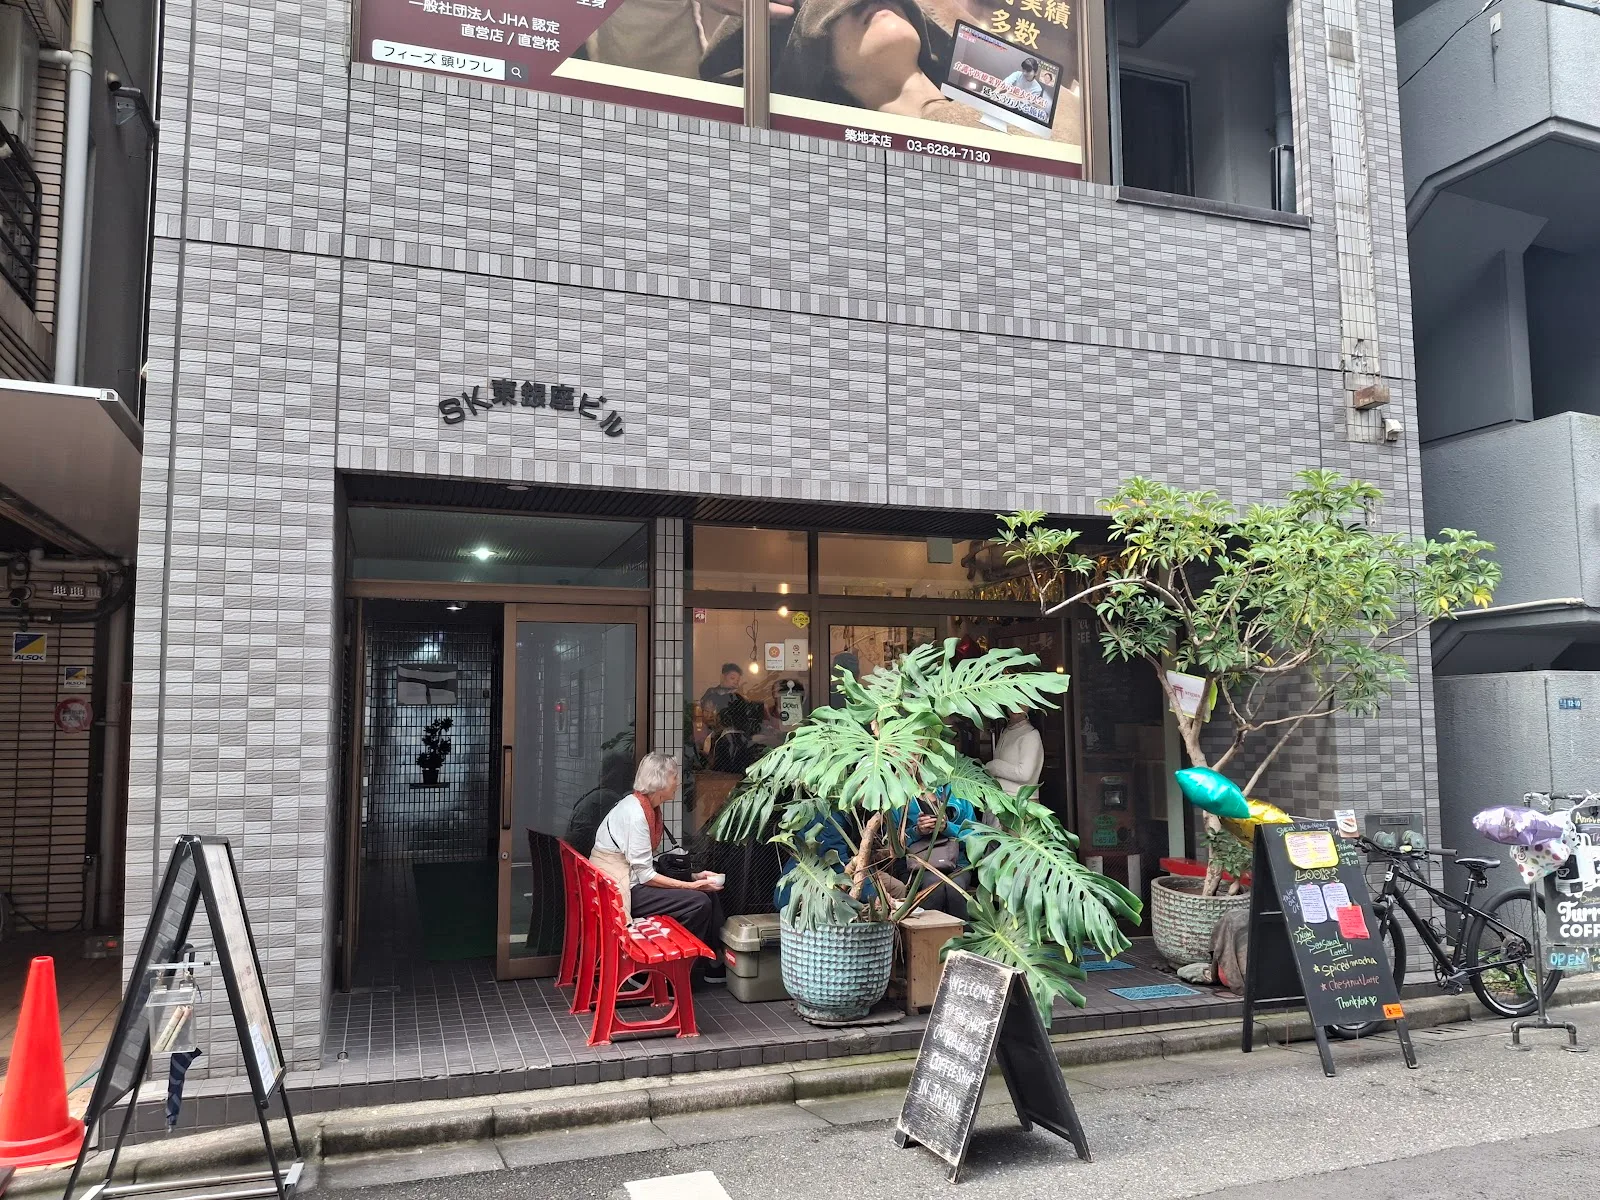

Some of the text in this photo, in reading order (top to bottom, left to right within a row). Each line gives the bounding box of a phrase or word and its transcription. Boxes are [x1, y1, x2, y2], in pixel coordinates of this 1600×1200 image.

[461, 23, 504, 43] 直営店
[518, 33, 561, 53] 直営校
[498, 13, 529, 29] JHA
[531, 17, 560, 35] 認定
[990, 9, 1041, 50] 多数
[383, 45, 494, 73] フィーズ 頭リフレ
[844, 128, 991, 164] 築地本店 03-6264-7130
[1550, 953, 1587, 967] OPEN
[949, 974, 995, 1004] WELCOME
